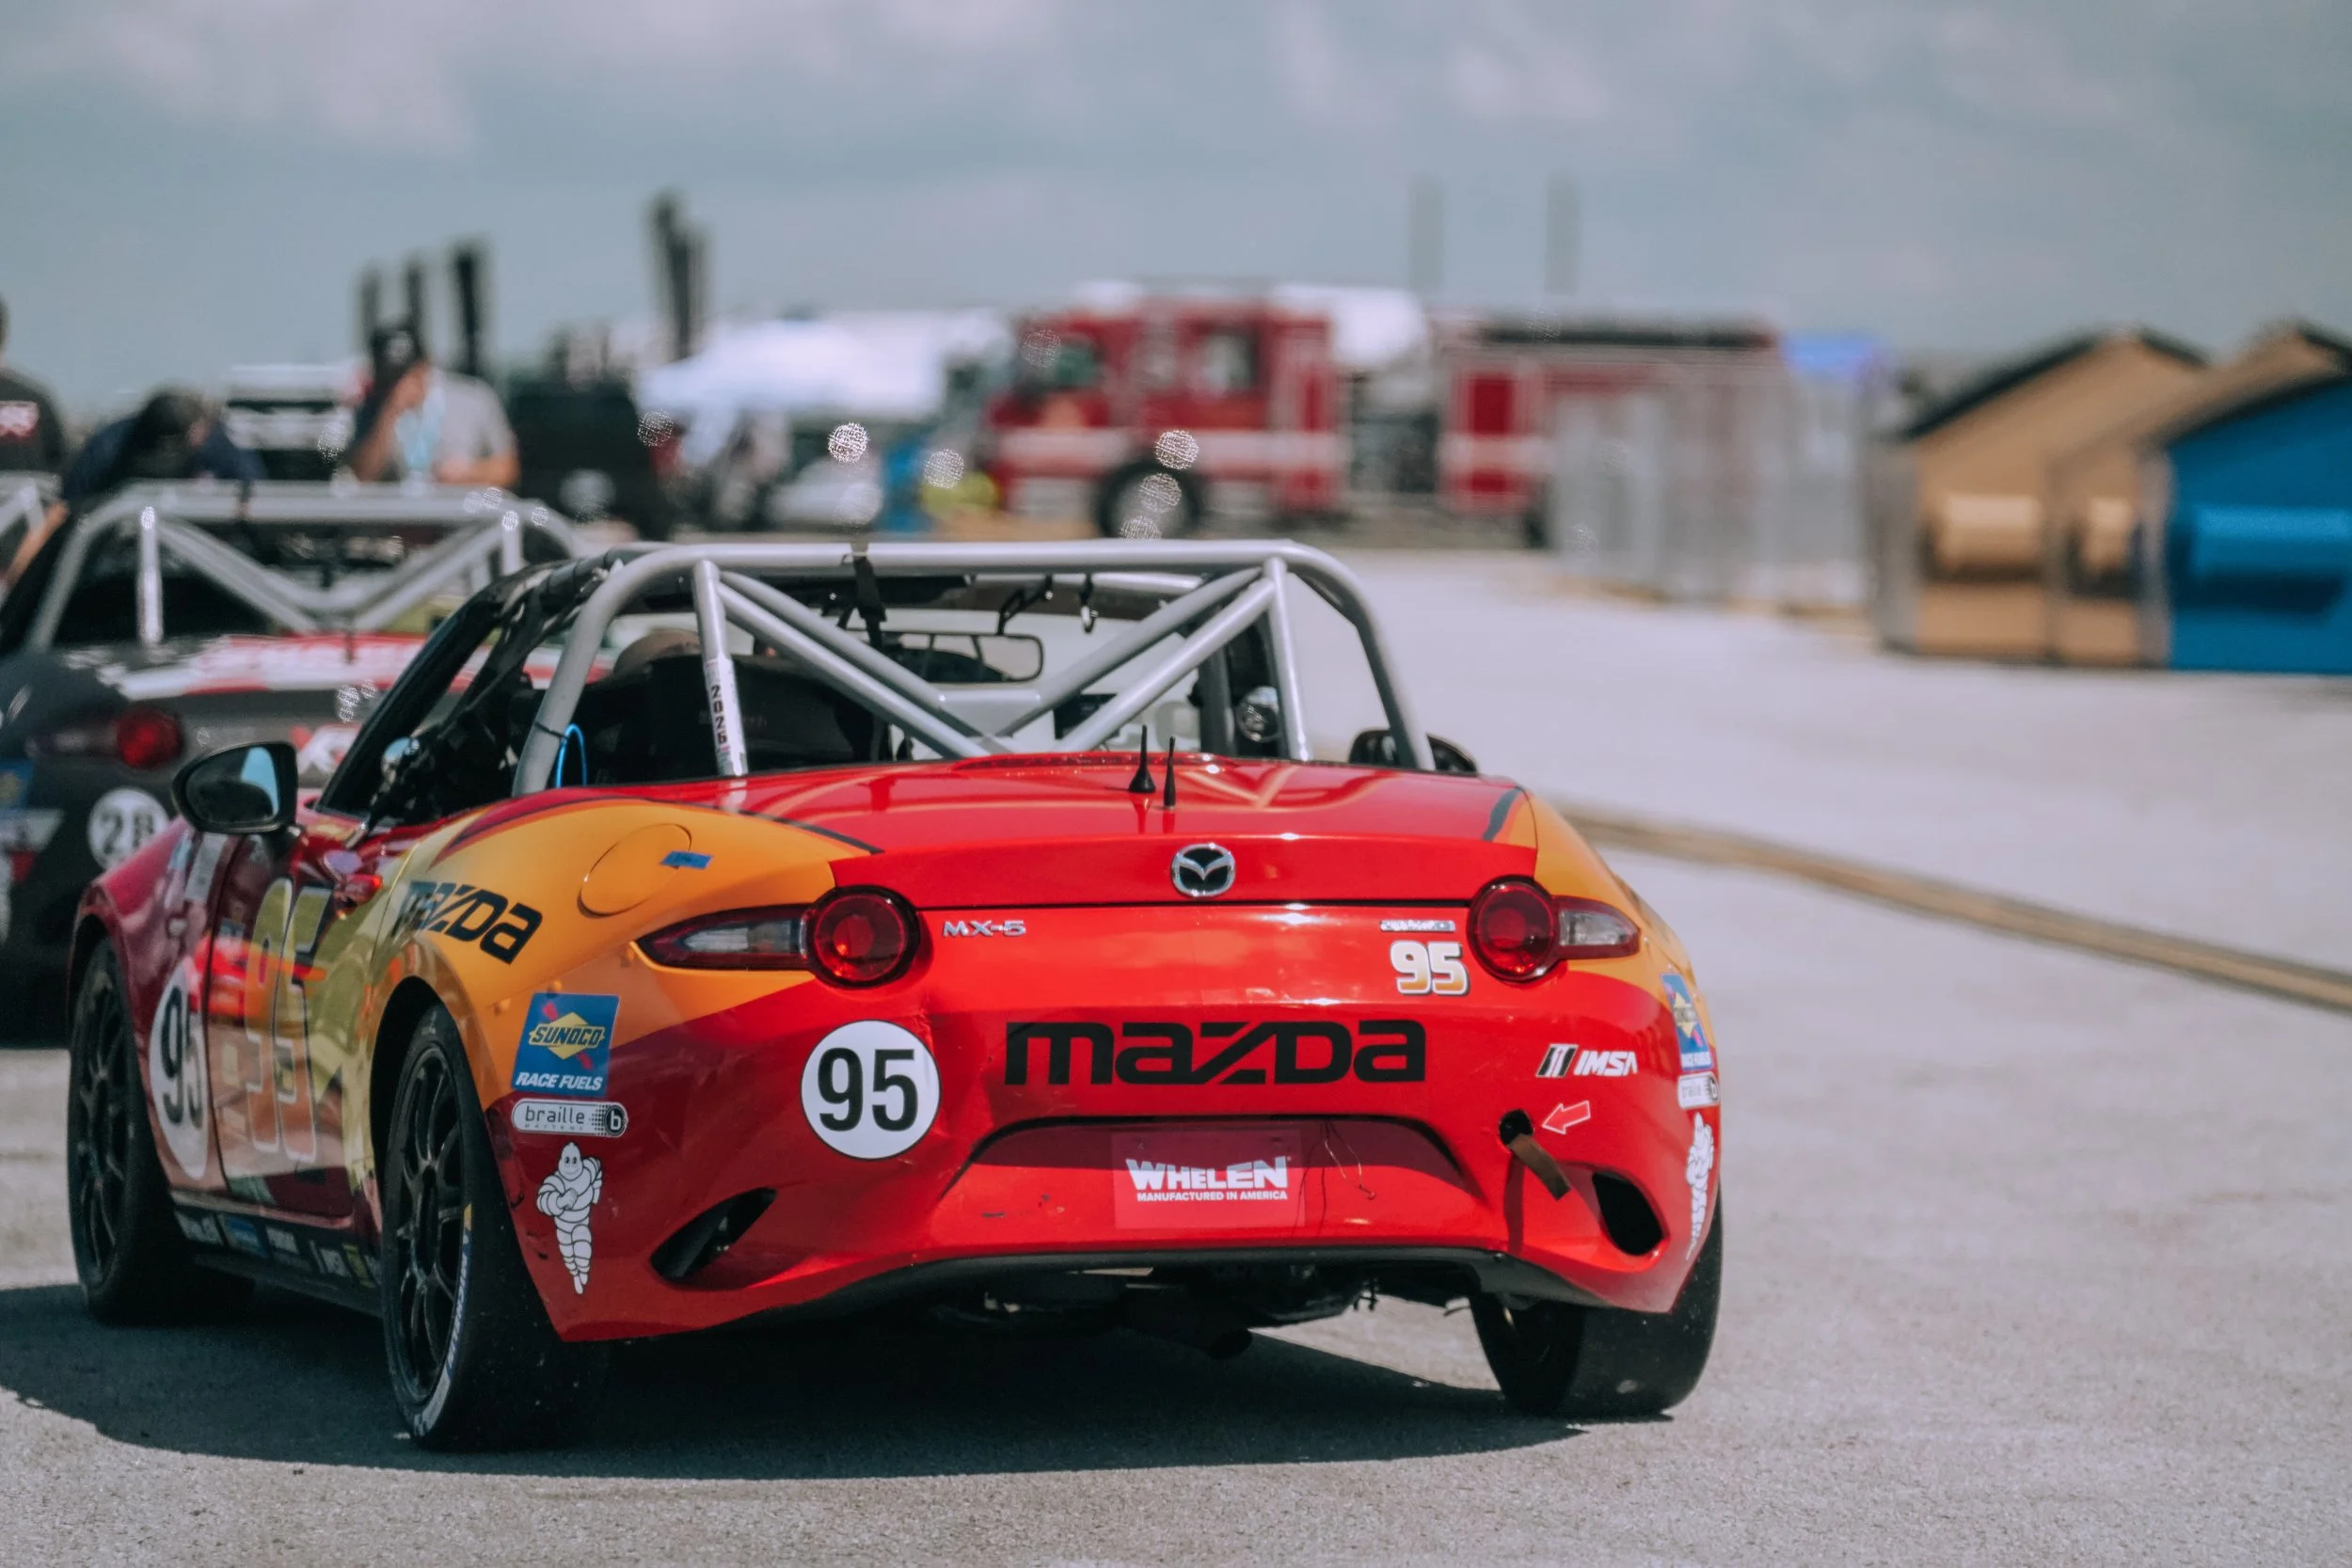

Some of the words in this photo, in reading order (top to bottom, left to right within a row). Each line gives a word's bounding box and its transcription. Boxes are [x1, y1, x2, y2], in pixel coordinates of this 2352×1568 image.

[943, 919, 1026, 937] MX-5
[1390, 940, 1470, 996] 95
[532, 1026, 603, 1046] SUNOCO
[1573, 1050, 1638, 1077] IMSA
[516, 1071, 557, 1088] RACE
[559, 1074, 603, 1091] FUELS
[817, 1046, 919, 1132] 95
[525, 1105, 585, 1124] braille
[1125, 1156, 1289, 1191] WHELEN
[1136, 1190, 1224, 1202] MANUFACTURED
[1226, 1191, 1237, 1201] IN
[1239, 1190, 1289, 1201] AMERICA
